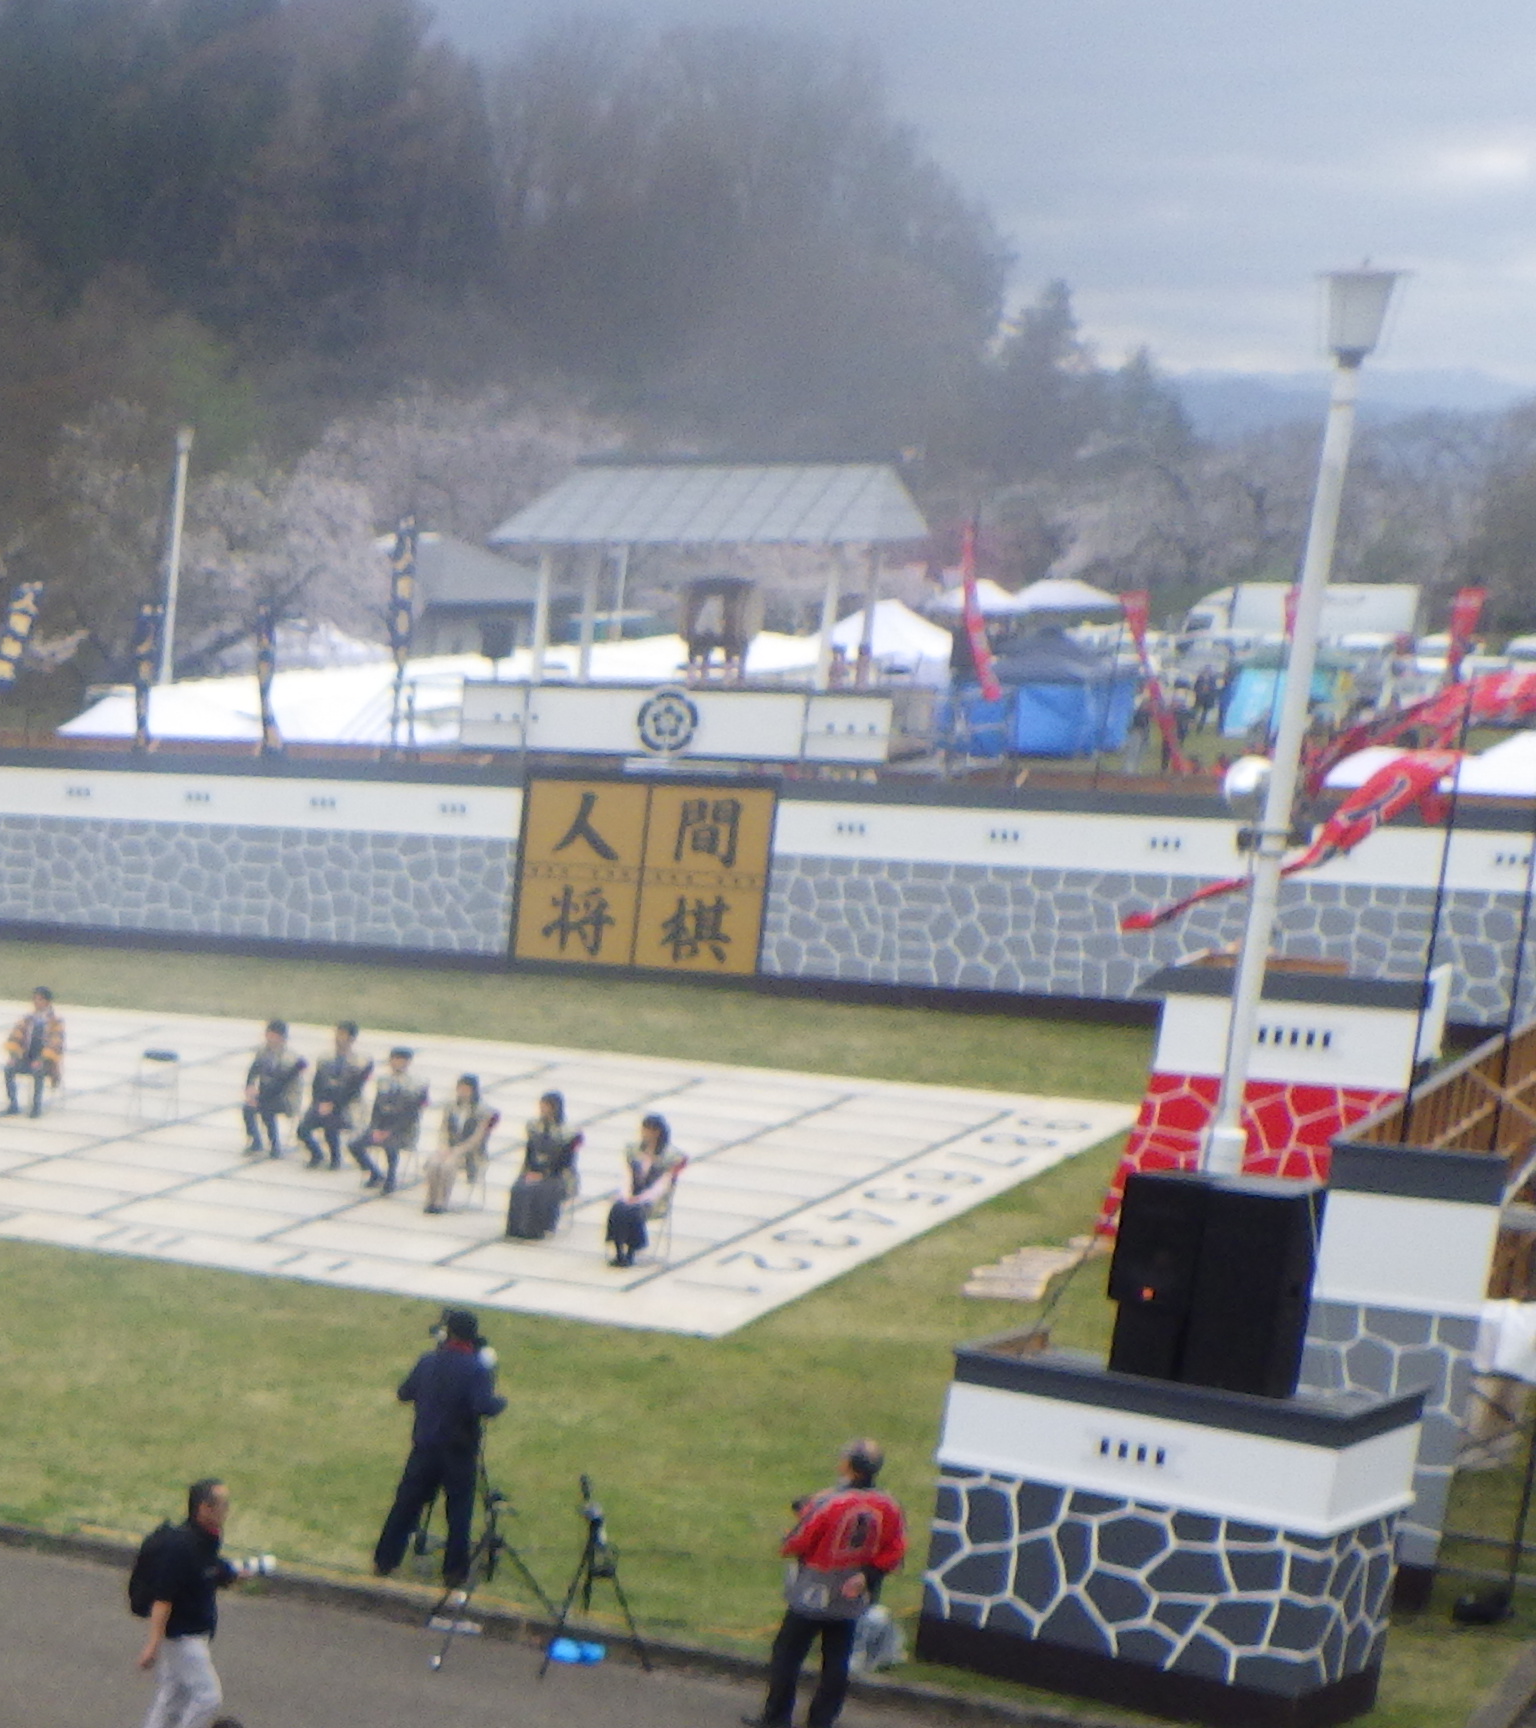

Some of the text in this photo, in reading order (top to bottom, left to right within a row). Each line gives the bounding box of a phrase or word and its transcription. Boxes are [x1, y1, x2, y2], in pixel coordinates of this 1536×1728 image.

[551, 792, 742, 868] 人間
[541, 884, 732, 964] 将棋
[947, 1151, 1030, 1168] 7
[863, 1187, 951, 1206] 5
[772, 1229, 861, 1250] 3
[717, 1249, 814, 1272] 2
